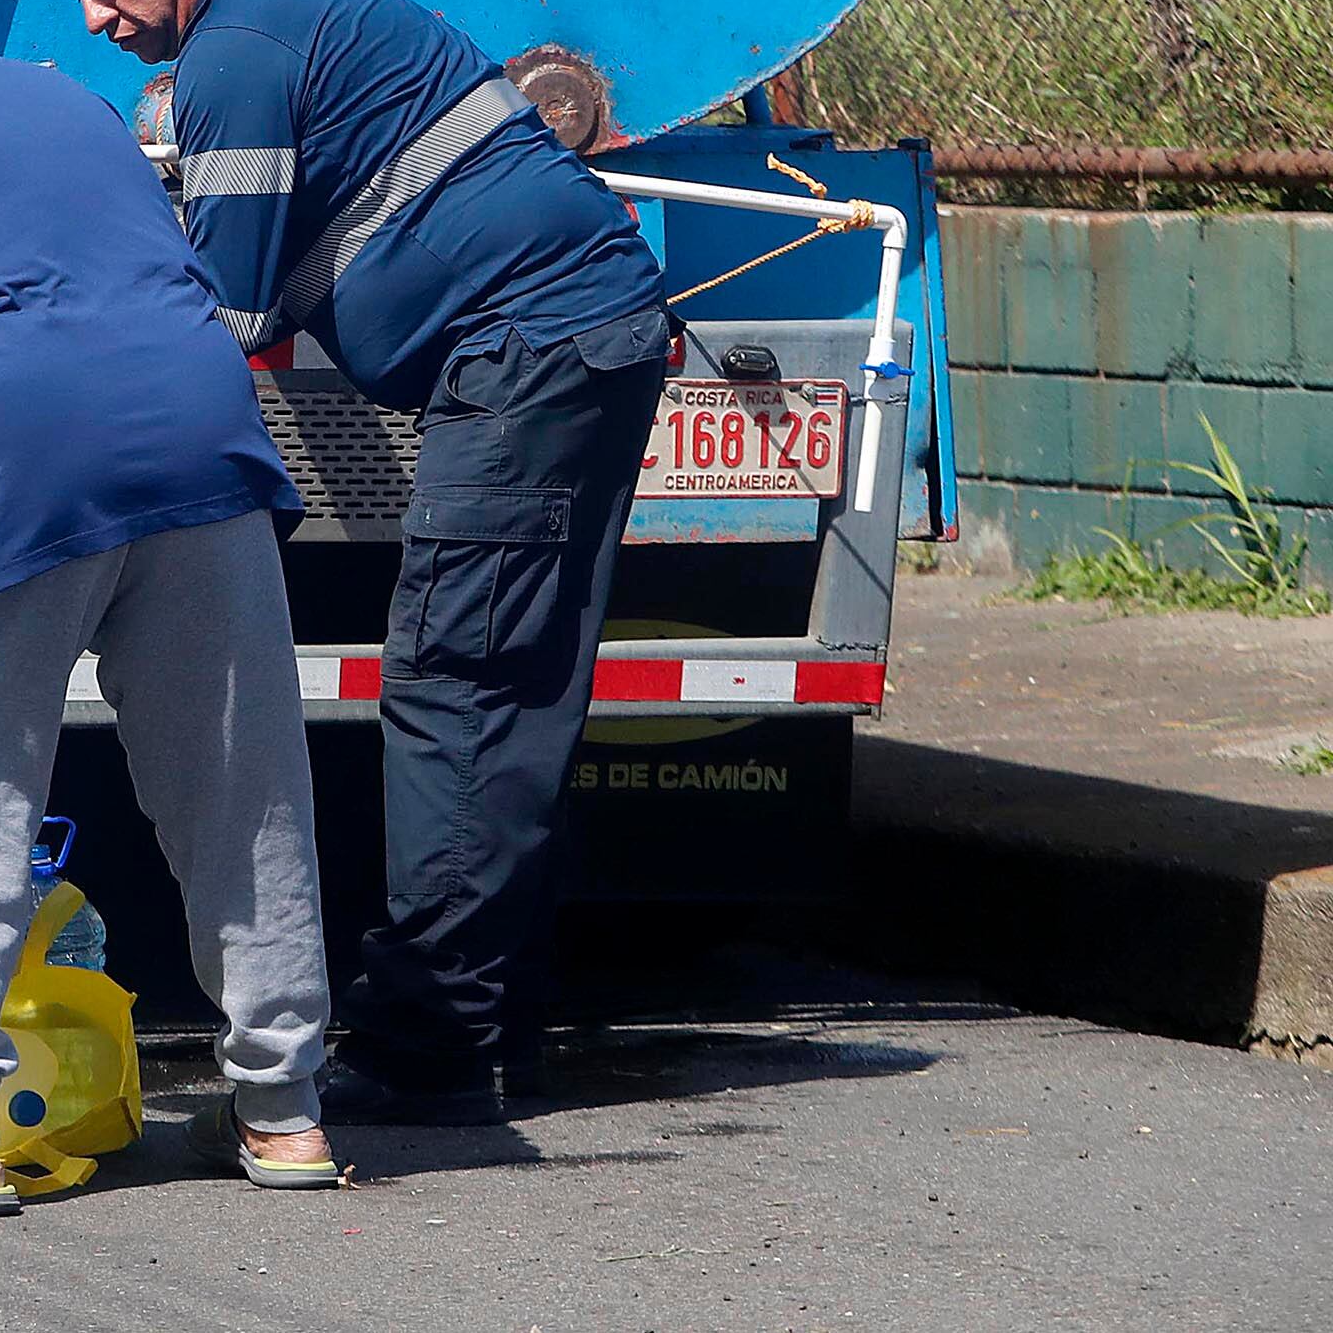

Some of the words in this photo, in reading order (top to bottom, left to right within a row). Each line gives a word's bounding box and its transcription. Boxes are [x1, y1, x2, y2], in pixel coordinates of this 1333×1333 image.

[684, 390, 739, 407] COSTA
[745, 390, 783, 406] RICA
[664, 474, 799, 491] CENTROAMERICA
[732, 676, 746, 685] 3M
[608, 763, 650, 788] DE
[657, 758, 788, 792] CAMIÓN
